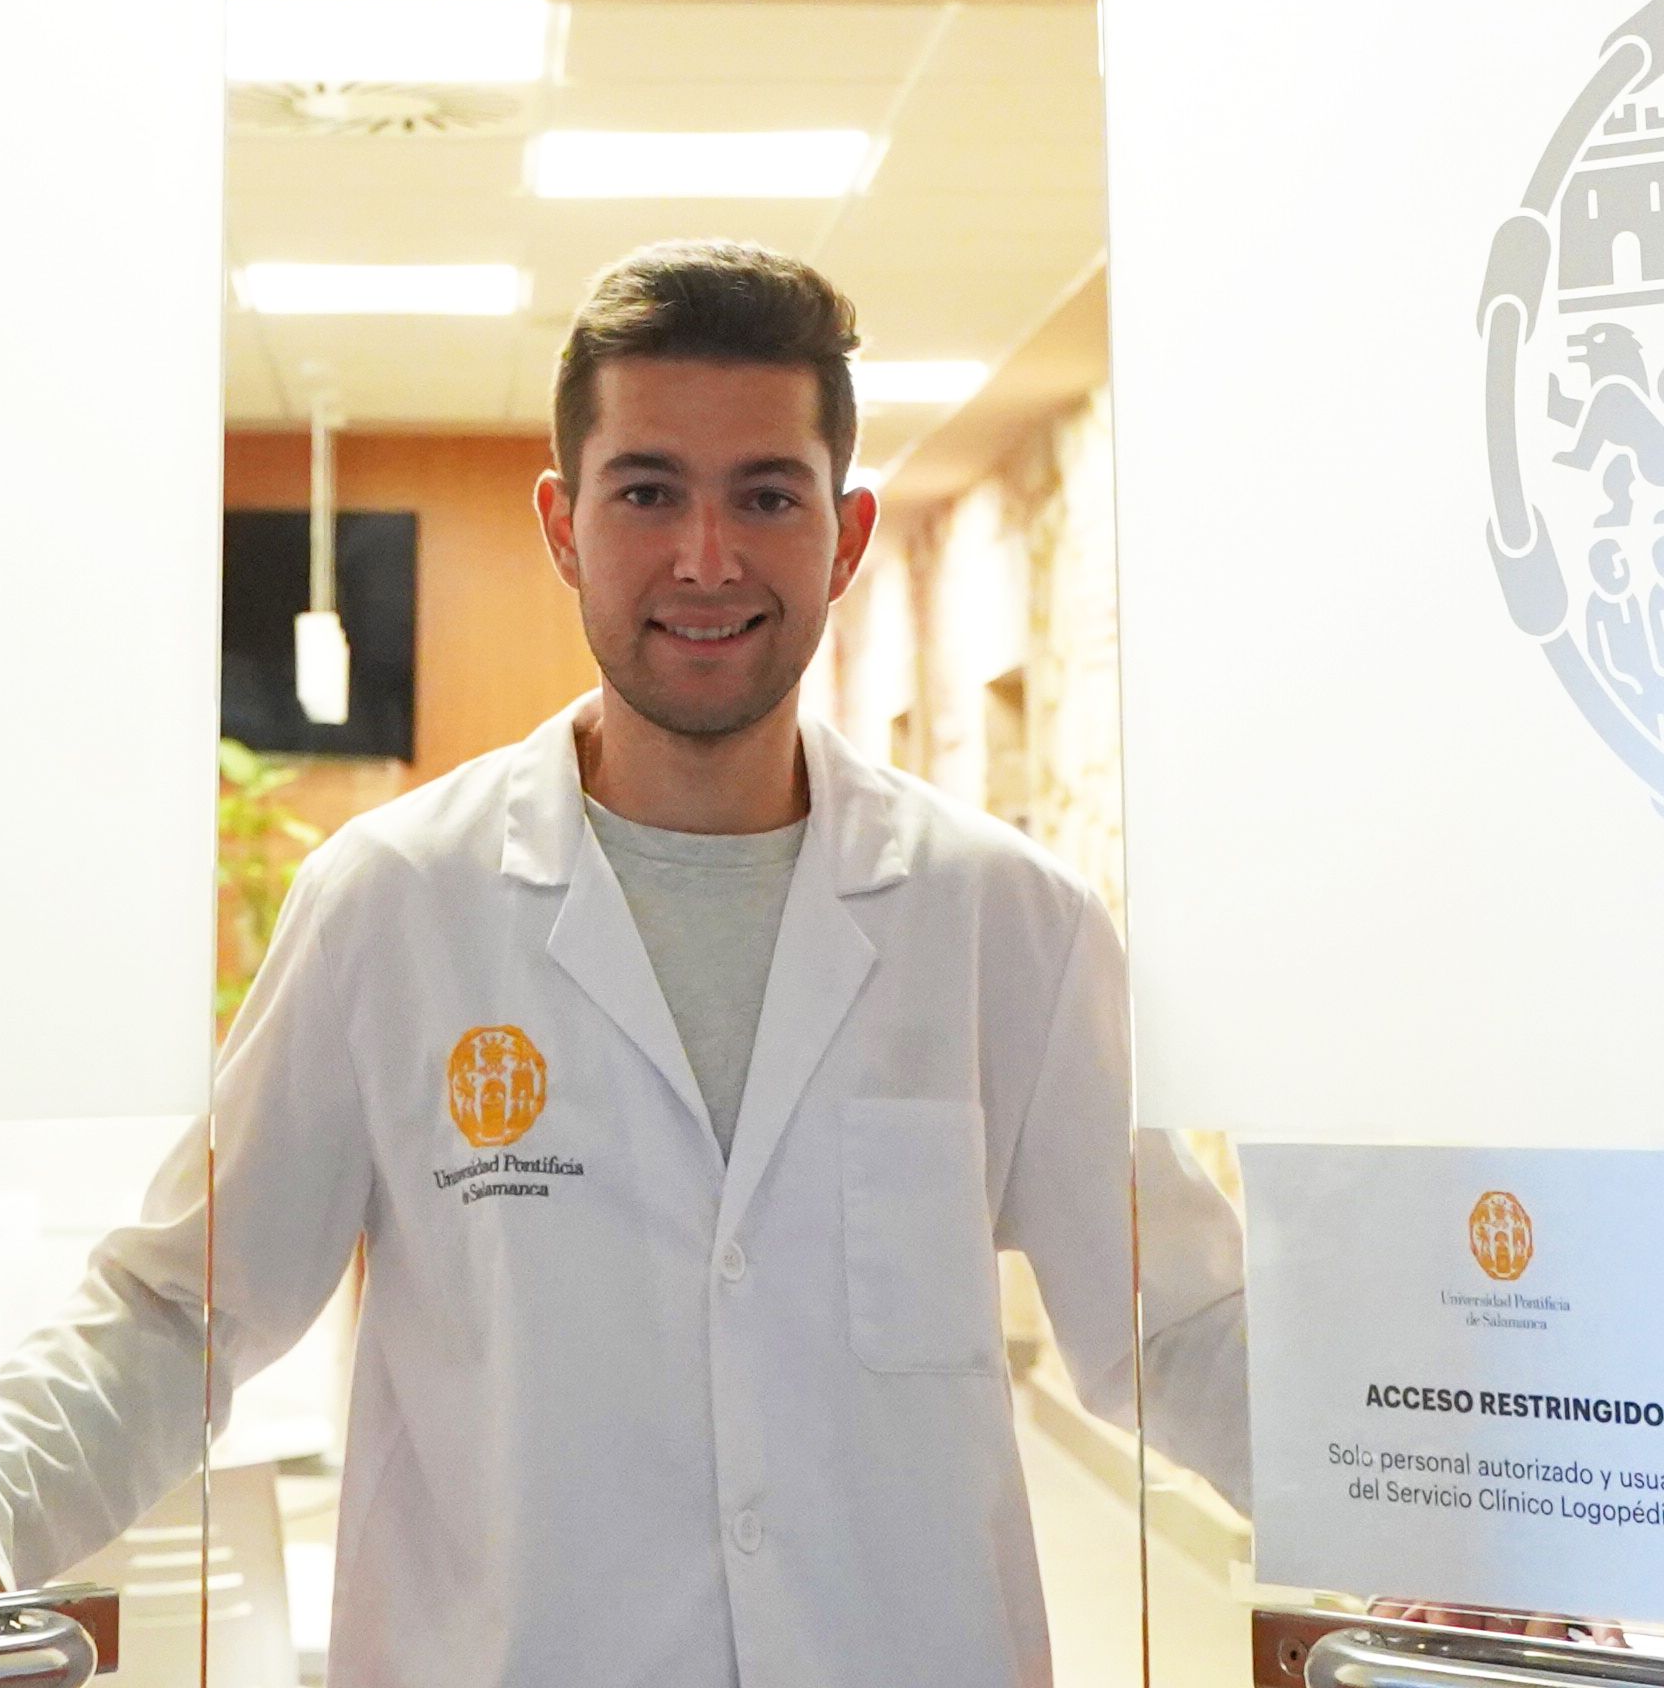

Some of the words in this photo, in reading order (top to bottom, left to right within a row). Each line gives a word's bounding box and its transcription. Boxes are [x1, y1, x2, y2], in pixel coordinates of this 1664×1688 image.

[503, 1154, 584, 1175] Pontificia
[469, 1180, 549, 1200] Salamanca
[1441, 1290, 1512, 1308] Universidad
[1514, 1293, 1570, 1312] Pontificia
[1466, 1312, 1480, 1326] de
[1482, 1312, 1548, 1330] Salamanca
[1366, 1384, 1474, 1413] ACCESO
[1480, 1391, 1664, 1427] RESTRINGIDO
[1329, 1443, 1374, 1467] Solo
[1381, 1452, 1470, 1475] personal
[1478, 1457, 1593, 1485] autorizado
[1599, 1469, 1612, 1491] y
[1349, 1477, 1380, 1501] del
[1387, 1481, 1472, 1508] Servicio
[1479, 1488, 1554, 1516] Clínico
